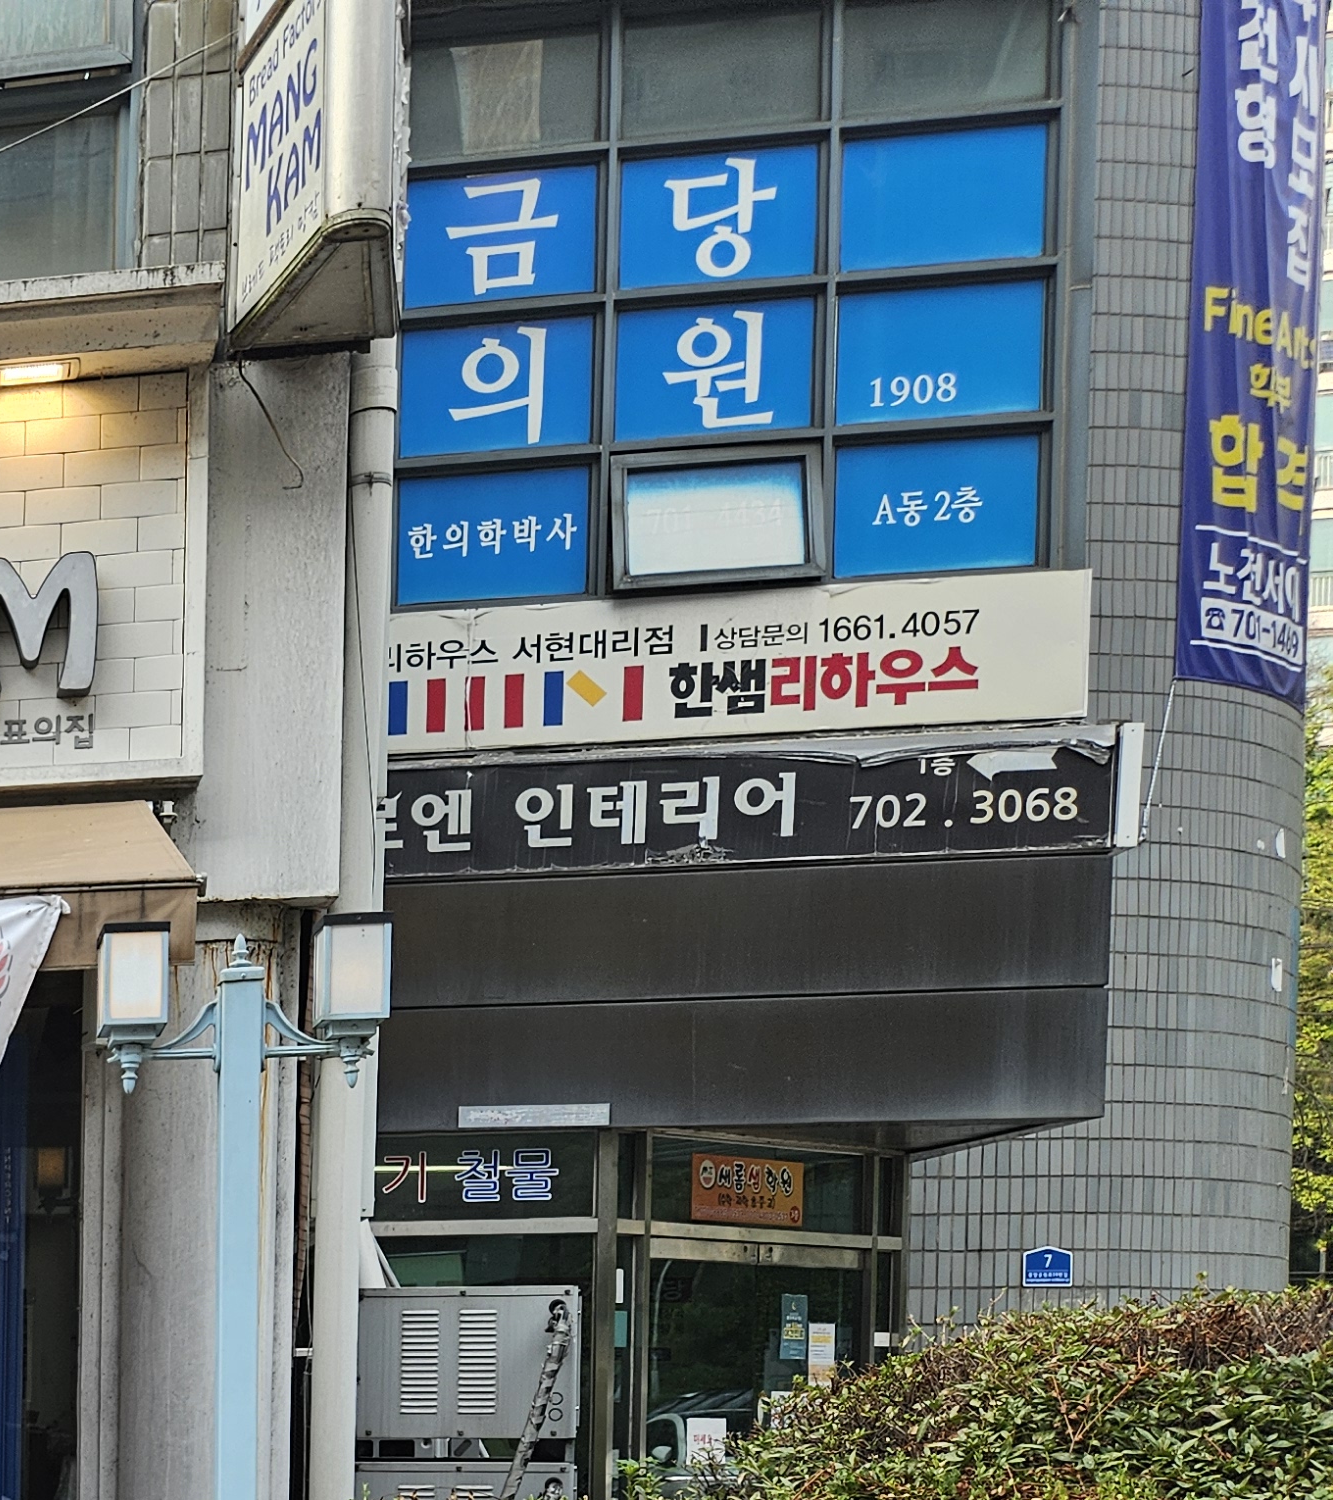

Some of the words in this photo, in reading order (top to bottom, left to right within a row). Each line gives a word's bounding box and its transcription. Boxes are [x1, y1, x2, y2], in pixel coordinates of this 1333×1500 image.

[249, 39, 279, 108] Bread
[245, 37, 318, 192] MANG
[265, 108, 321, 237] KAM
[869, 373, 958, 408] 1908
[408, 512, 579, 560] 한의학박사
[512, 627, 674, 664] 서현대리점
[714, 623, 809, 651] 상담문의
[818, 609, 981, 643] 1661.4057
[515, 772, 796, 848] 인테리어
[454, 1147, 559, 1203] 철물
[1044, 1254, 1053, 1268] 7
